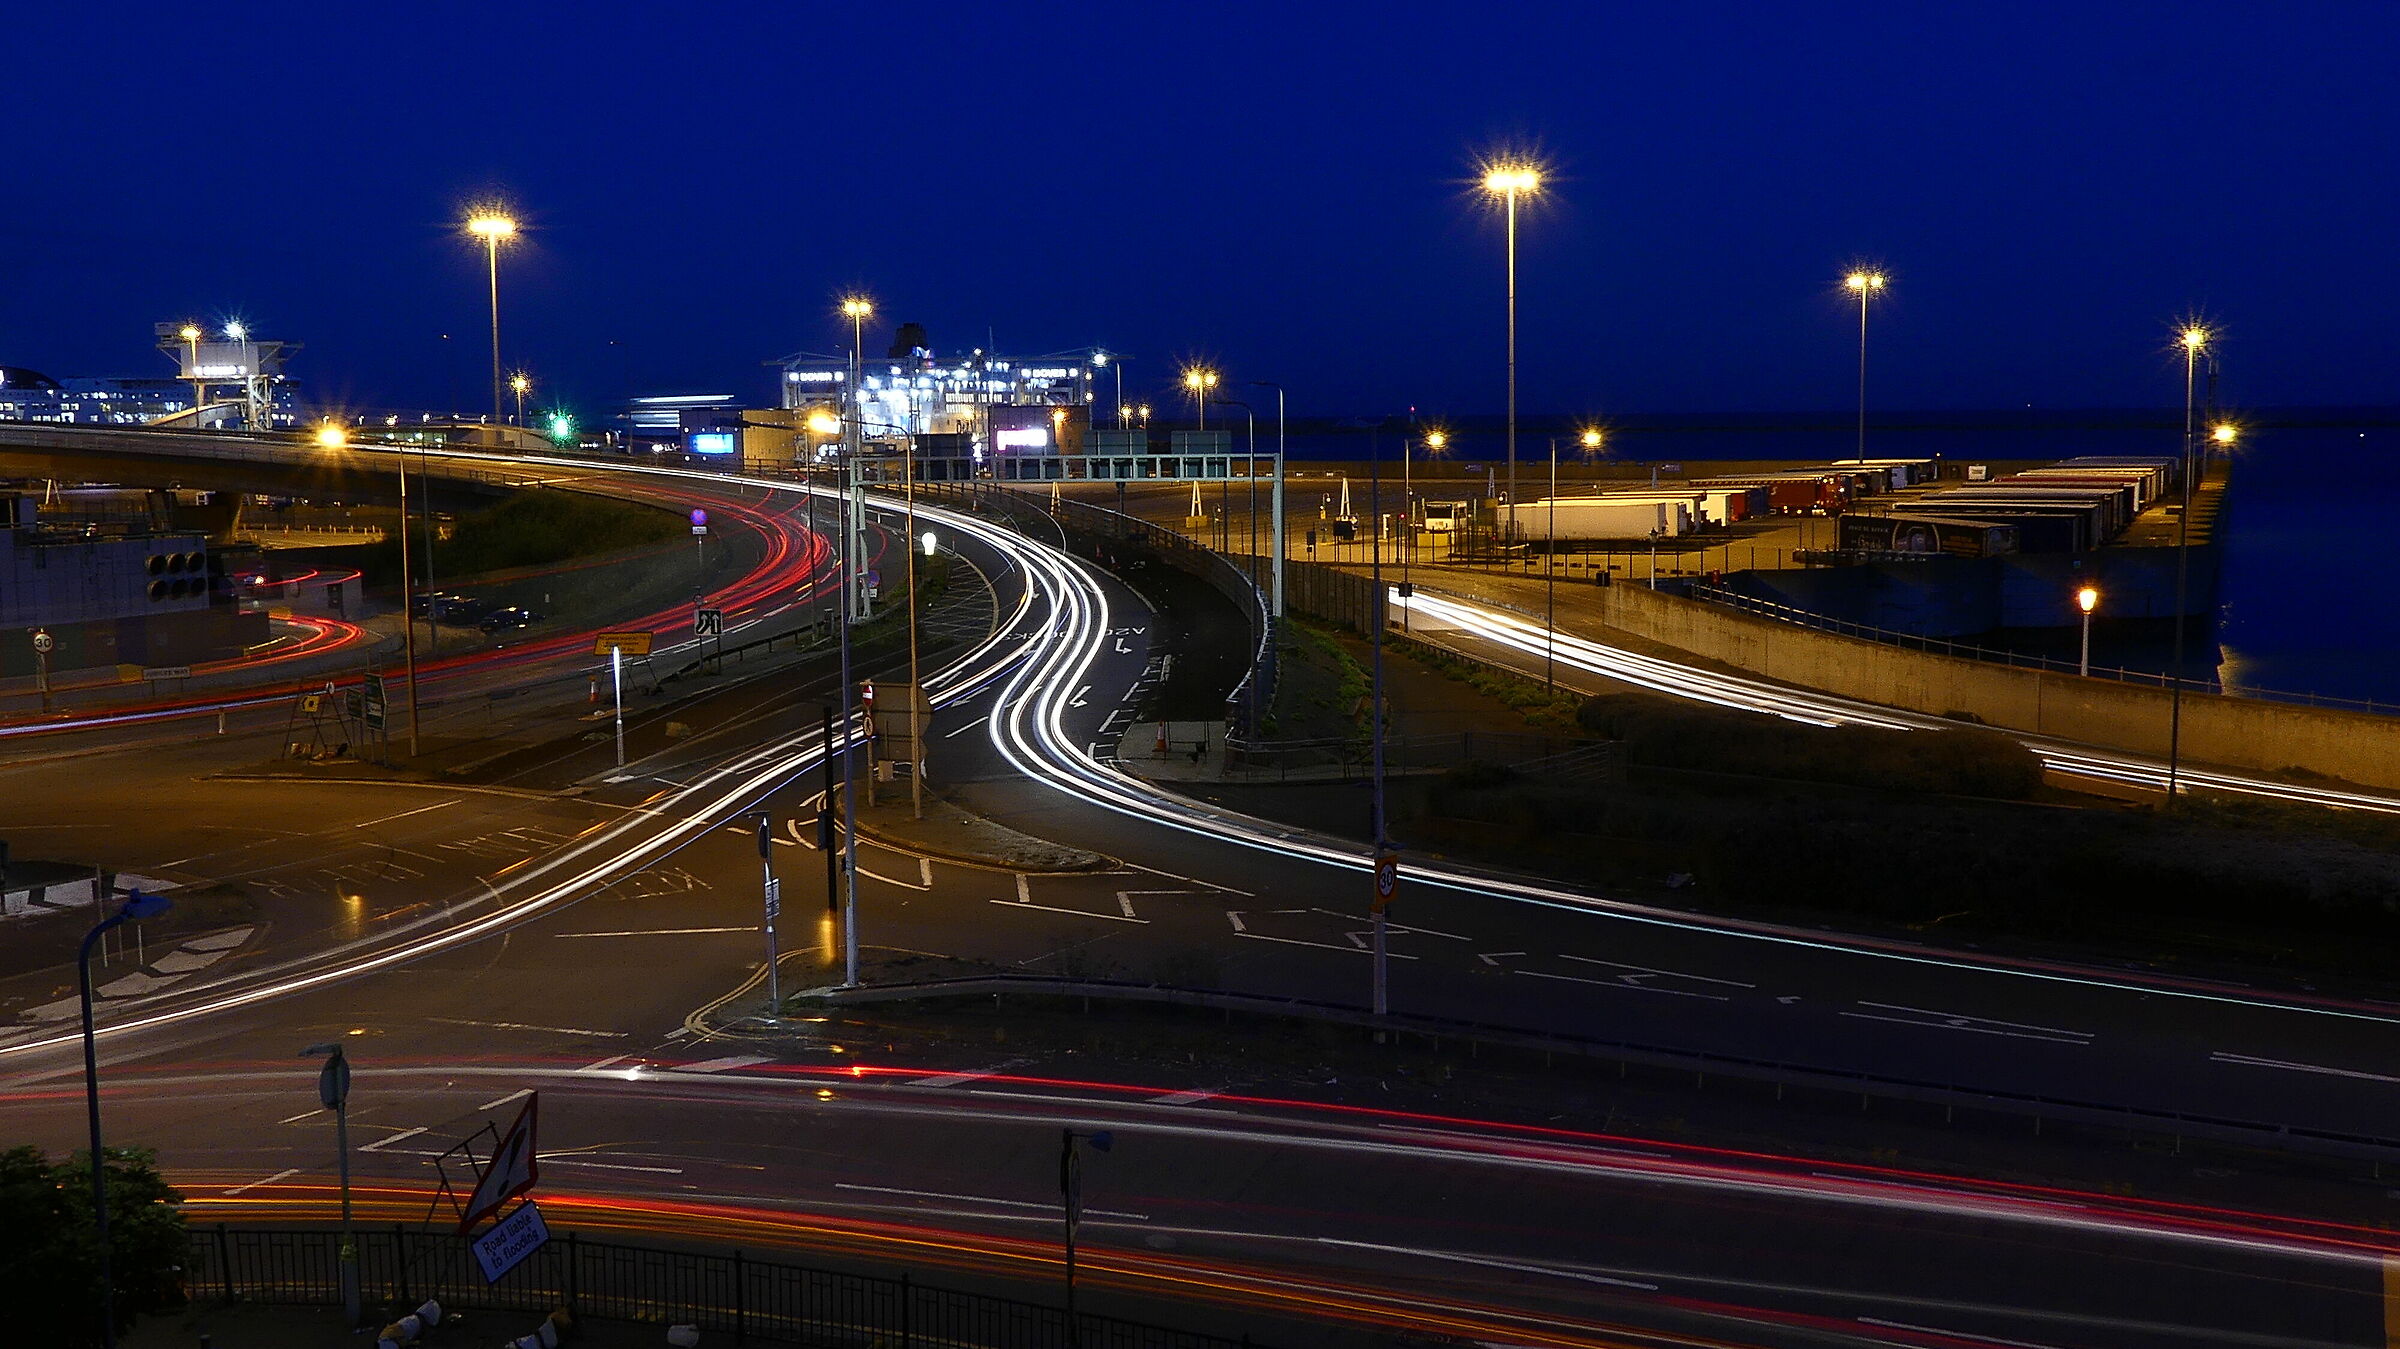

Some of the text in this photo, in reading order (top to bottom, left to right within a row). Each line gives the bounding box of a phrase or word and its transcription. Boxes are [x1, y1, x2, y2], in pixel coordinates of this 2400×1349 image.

[35, 638, 52, 648] 30
[1380, 870, 1393, 889] 30
[483, 1214, 532, 1255] Road liable
[491, 1229, 539, 1269] to flooding
